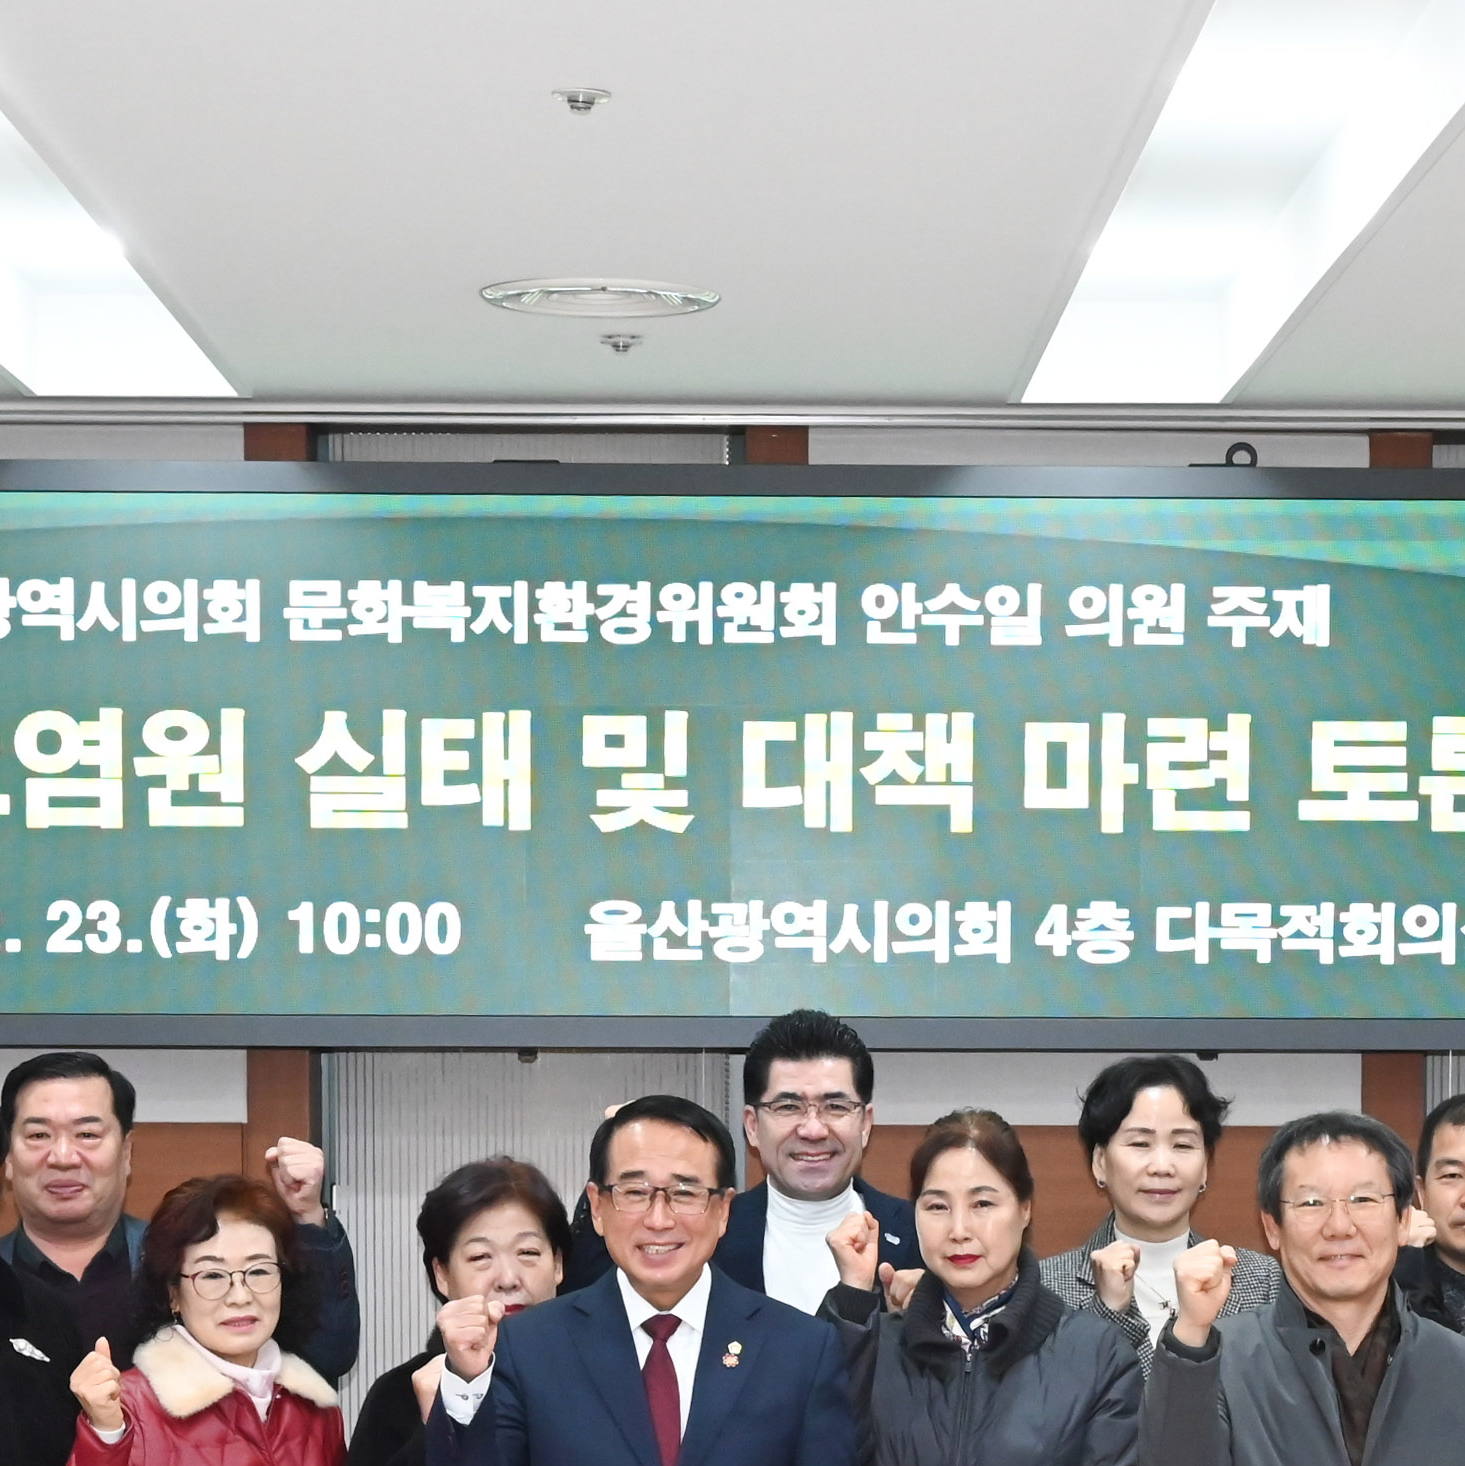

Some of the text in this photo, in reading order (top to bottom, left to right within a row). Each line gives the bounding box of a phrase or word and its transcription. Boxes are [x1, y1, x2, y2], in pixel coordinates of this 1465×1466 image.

[283, 580, 836, 645] 문화복지환경위원회
[862, 583, 1042, 646] 안수일
[1065, 583, 1185, 647] 의원
[1208, 584, 1330, 647] 주재
[295, 709, 531, 831] 실태
[582, 710, 695, 833] 및
[742, 711, 974, 832] 대책
[1024, 713, 1251, 834] 마련
[46, 896, 258, 960] 23.(화)
[288, 902, 461, 955] 10:00
[584, 899, 1011, 963] 울산광역시의회
[1035, 901, 1134, 964] 4층
